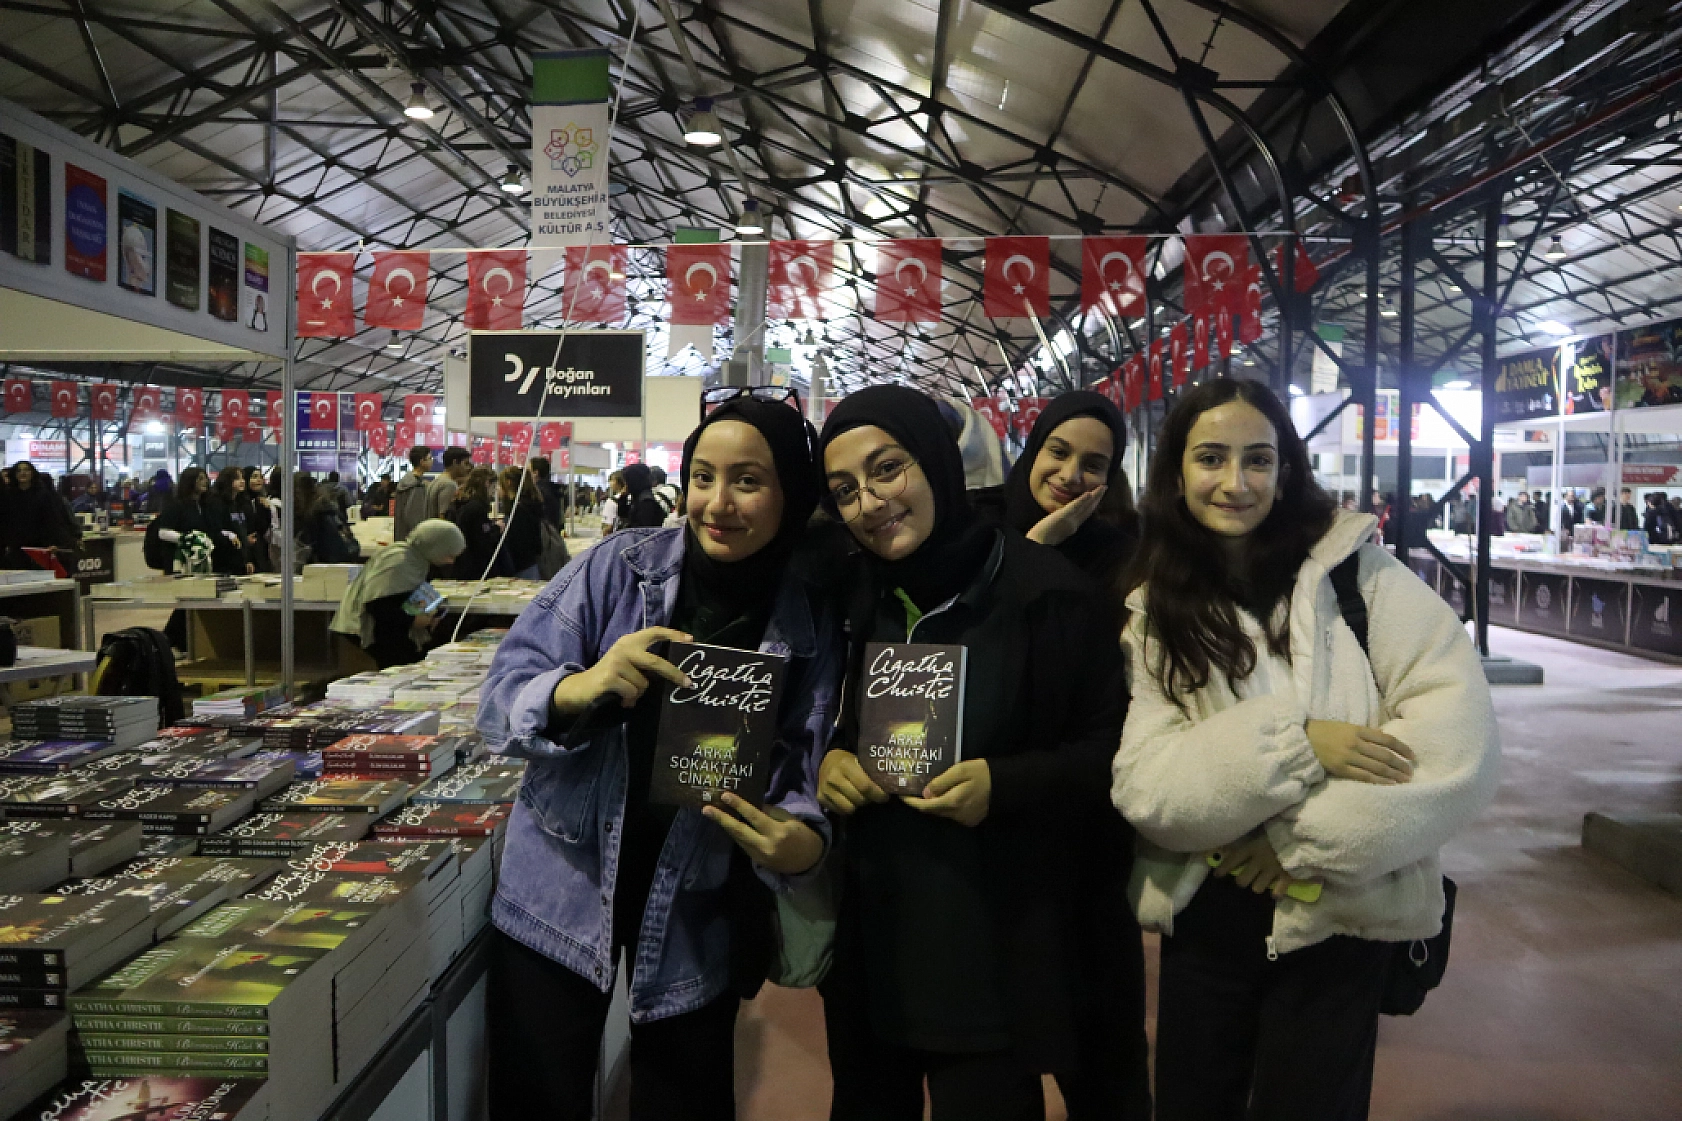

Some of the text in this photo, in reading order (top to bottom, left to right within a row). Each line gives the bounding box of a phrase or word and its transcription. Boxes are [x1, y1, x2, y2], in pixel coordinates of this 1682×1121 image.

[546, 182, 595, 194] MALATYA
[534, 191, 606, 208] BÜYÜKŞEHİR
[543, 207, 596, 220] BELEDİYESİ
[538, 222, 582, 235] KÜLTÜR
[545, 366, 595, 383] Doğan
[547, 381, 611, 399] Yayınları
[678, 650, 773, 687] Agatha
[869, 647, 953, 680] Agatha
[867, 672, 954, 700] Christie
[669, 679, 773, 713] Christie
[888, 733, 925, 746] ARKA
[693, 744, 734, 761] ARKA
[870, 745, 943, 761] SOKAKTAKİ
[669, 754, 753, 777] SOKAKTAKİ
[877, 758, 933, 774] CİNAYET
[678, 770, 741, 789] CİNAYET
[73, 1003, 114, 1014] AGATHA
[115, 1003, 164, 1014] CHRISTIE
[115, 1020, 164, 1032] CHRISTIE
[82, 1037, 114, 1048] GATHA
[115, 1038, 163, 1049] CHRISTIE
[87, 1054, 113, 1066] ATHA
[114, 1055, 163, 1067] CHRISTIE
